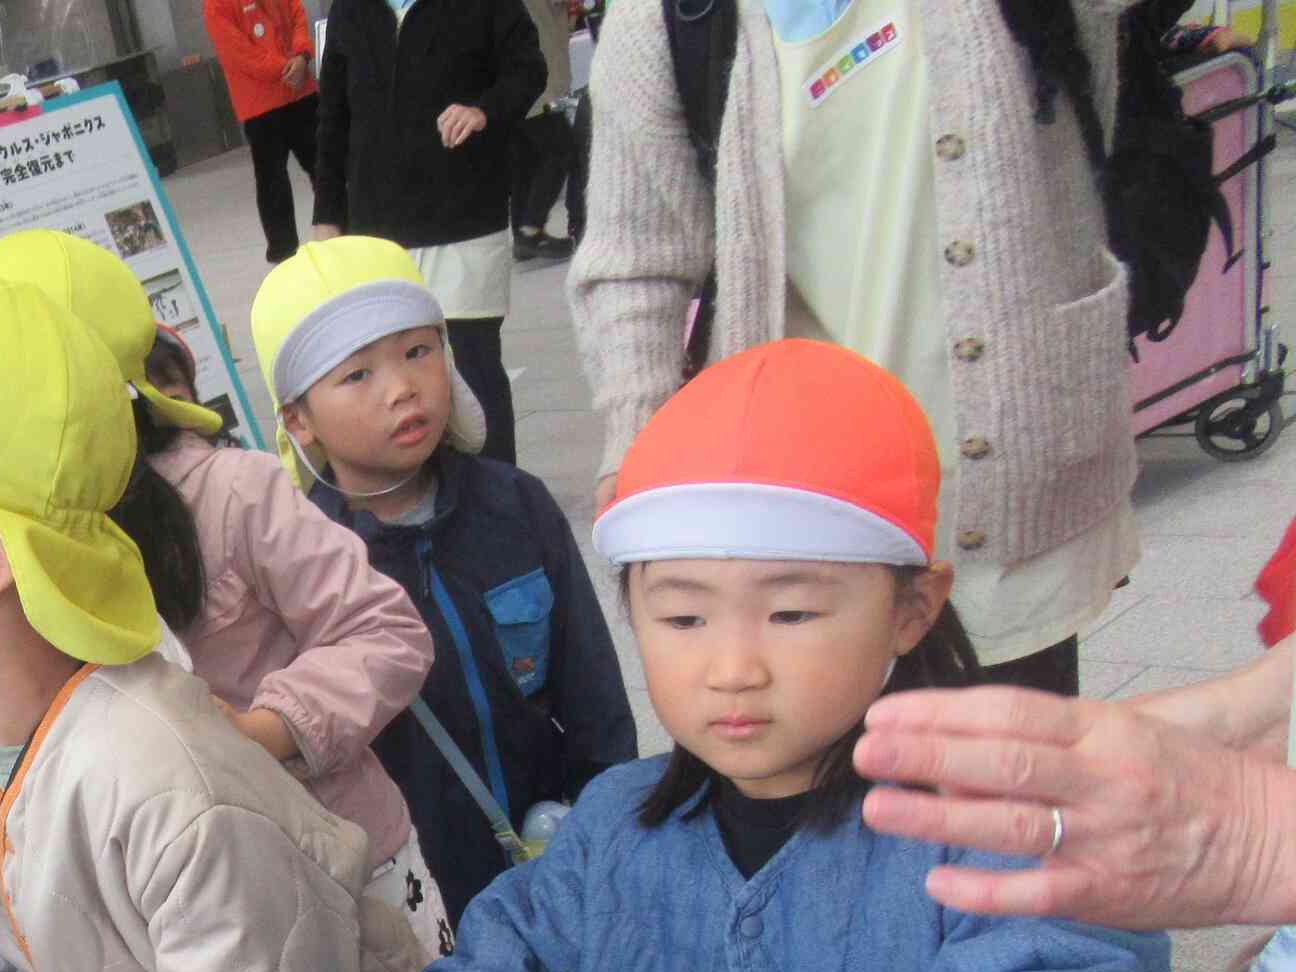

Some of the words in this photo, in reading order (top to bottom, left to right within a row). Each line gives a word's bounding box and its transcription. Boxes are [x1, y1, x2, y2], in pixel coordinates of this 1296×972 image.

[0, 149, 75, 185] 完全復元まで
